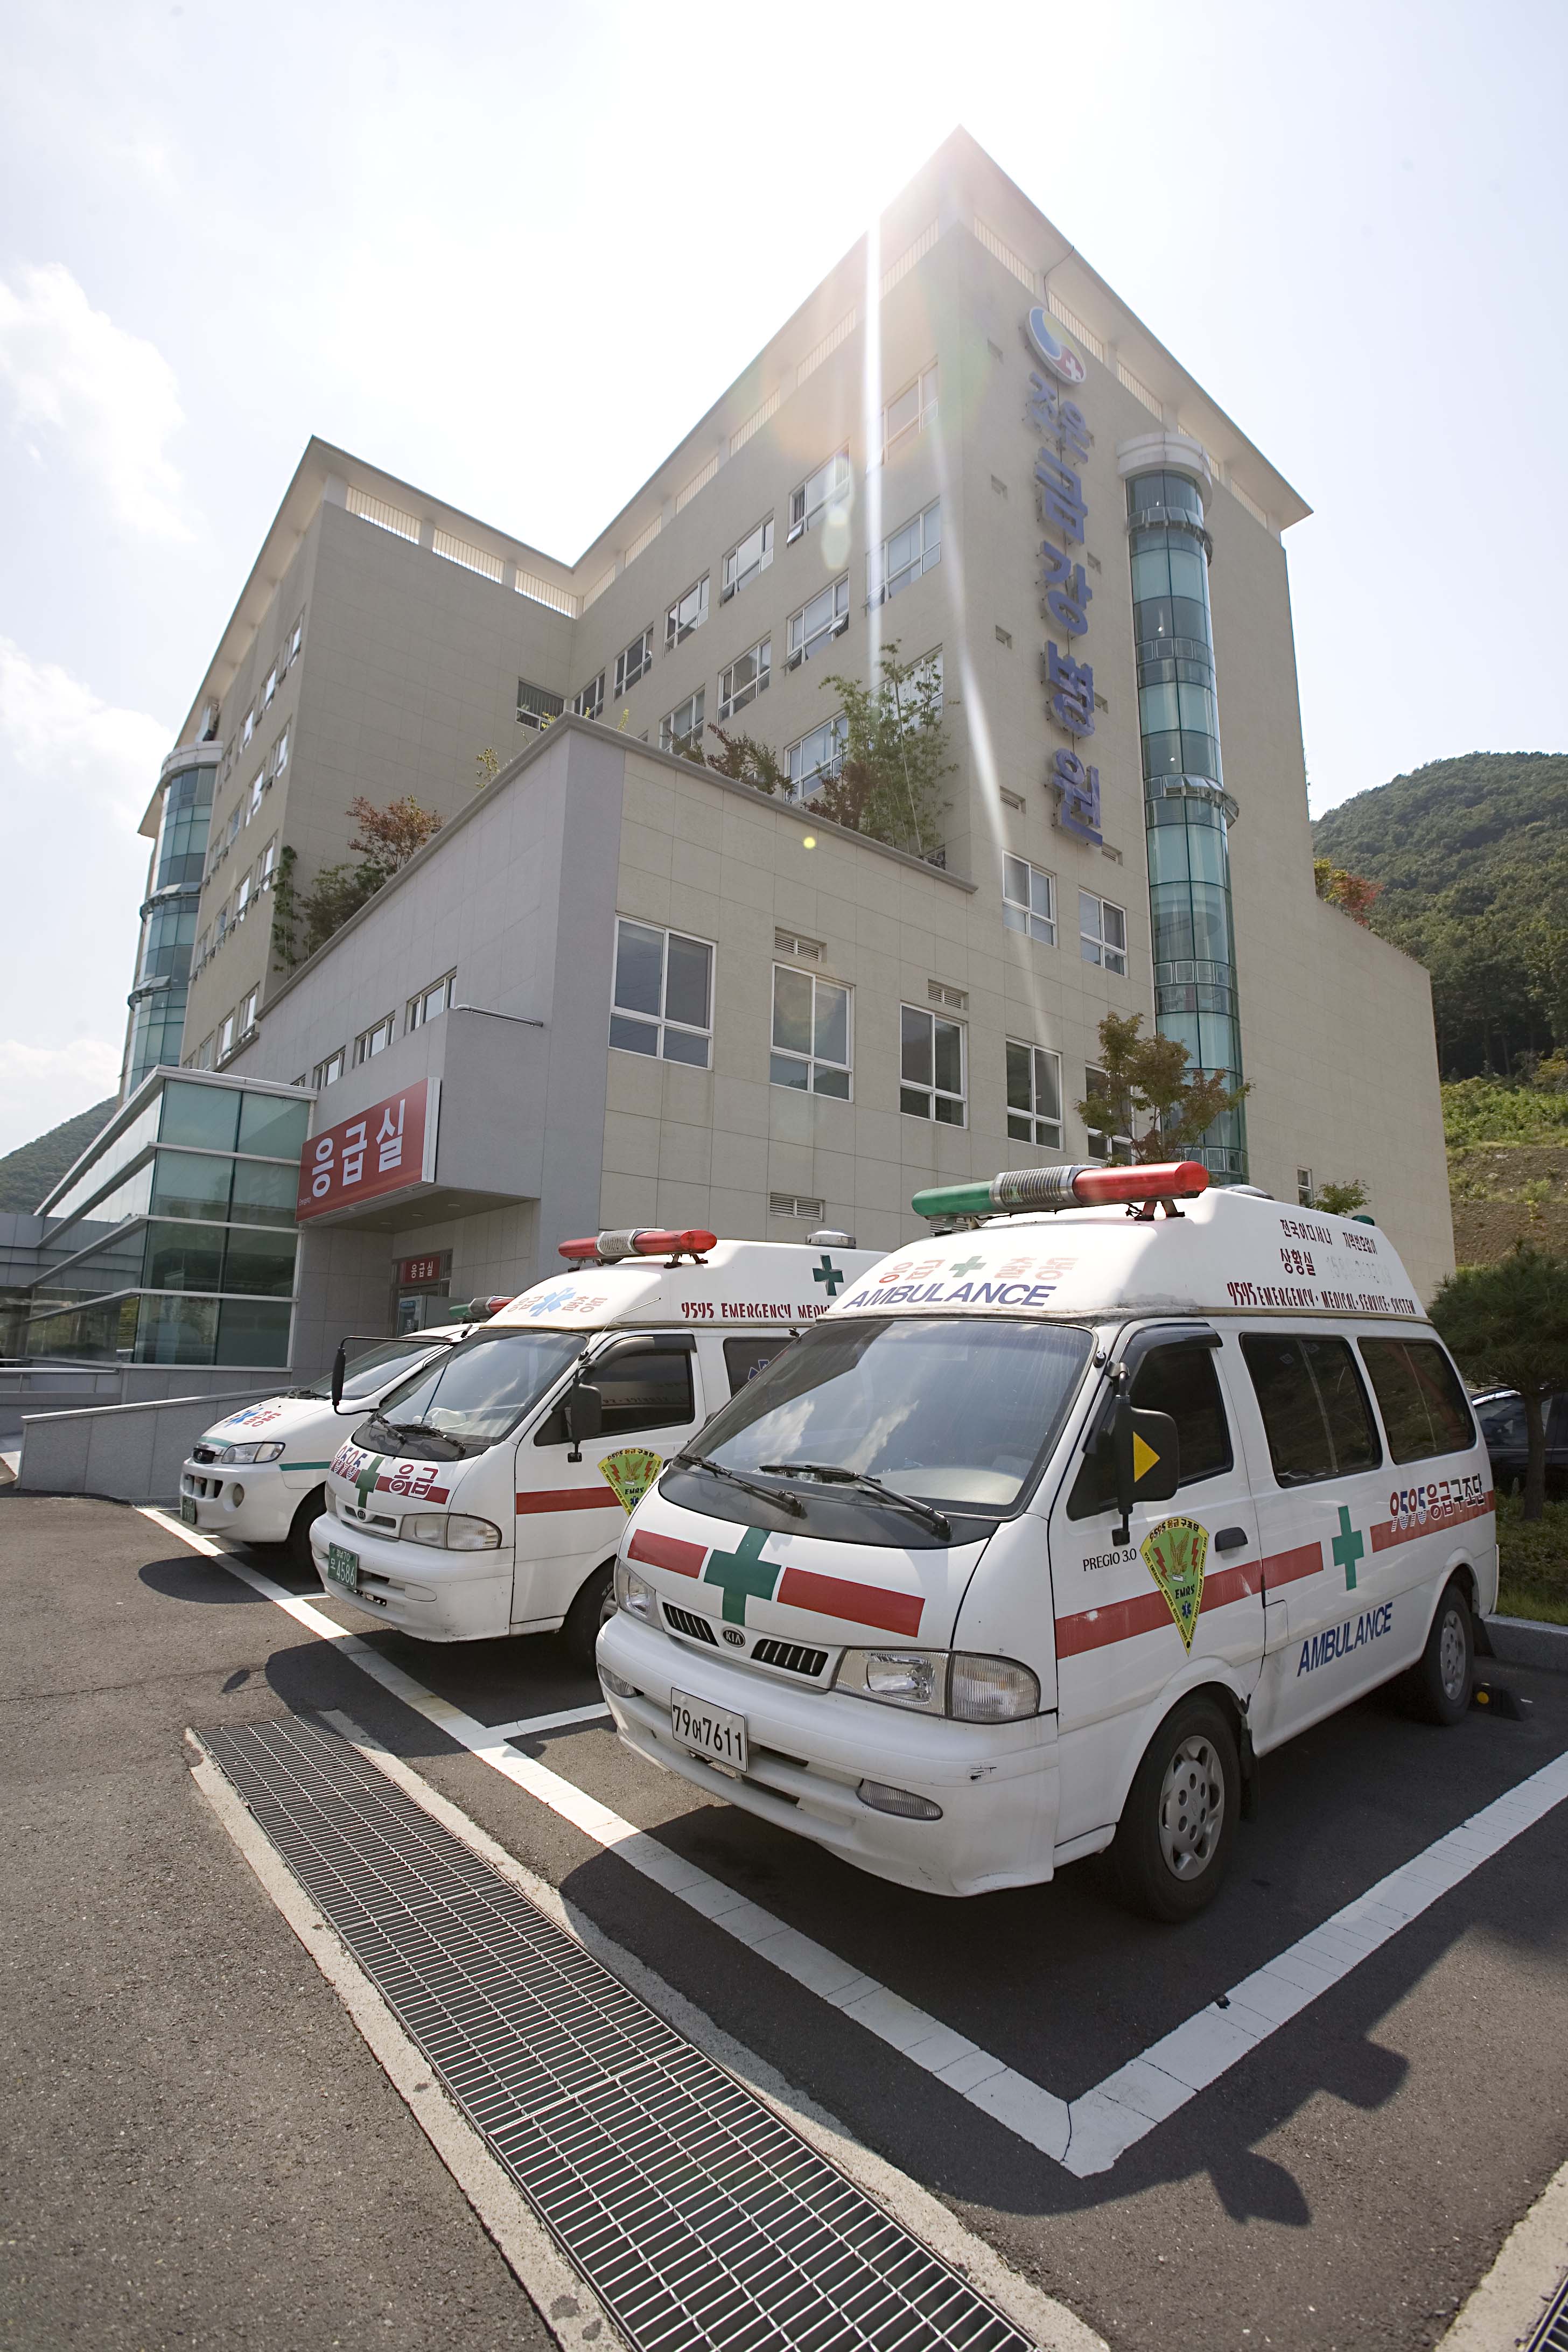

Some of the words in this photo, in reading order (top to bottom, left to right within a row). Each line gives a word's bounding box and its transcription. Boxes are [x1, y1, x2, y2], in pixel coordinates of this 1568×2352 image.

[312, 1098, 405, 1198] 응급실
[1280, 1219, 1333, 1245] 전국어디서나
[1342, 1232, 1378, 1255] 지역번호없이
[411, 1260, 434, 1279] 응급실
[879, 1258, 946, 1284] 응급
[994, 1256, 1079, 1280] 출동
[1280, 1248, 1316, 1276] 상황실
[507, 1296, 544, 1312] 응급
[561, 1296, 608, 1313] 출동
[843, 1282, 1057, 1309] AMBULANCE
[1227, 1282, 1257, 1306] 9595
[1257, 1286, 1315, 1306] EMERGENCY
[1321, 1291, 1357, 1310] MEDICAL
[1359, 1294, 1388, 1312] SERVICE
[1391, 1297, 1416, 1314] SYSTEM
[681, 1302, 715, 1318] 9595
[721, 1303, 792, 1318] EMERGENCY
[607, 1450, 623, 1462] 9595
[637, 1448, 655, 1458] 구조단
[389, 1464, 439, 1499] 응급
[625, 1487, 644, 1495] EMRS
[1150, 1522, 1166, 1543] 9595
[1167, 1518, 1179, 1529] 응급
[1181, 1518, 1199, 1532] 구조단
[1082, 1550, 1121, 1572] PREGIO
[1122, 1548, 1137, 1561] 3.0
[337, 1560, 354, 1586] 4586
[1174, 1584, 1195, 1599] EMRS
[726, 1631, 741, 1644] KIA
[1297, 1601, 1393, 1677] AMBULANCE
